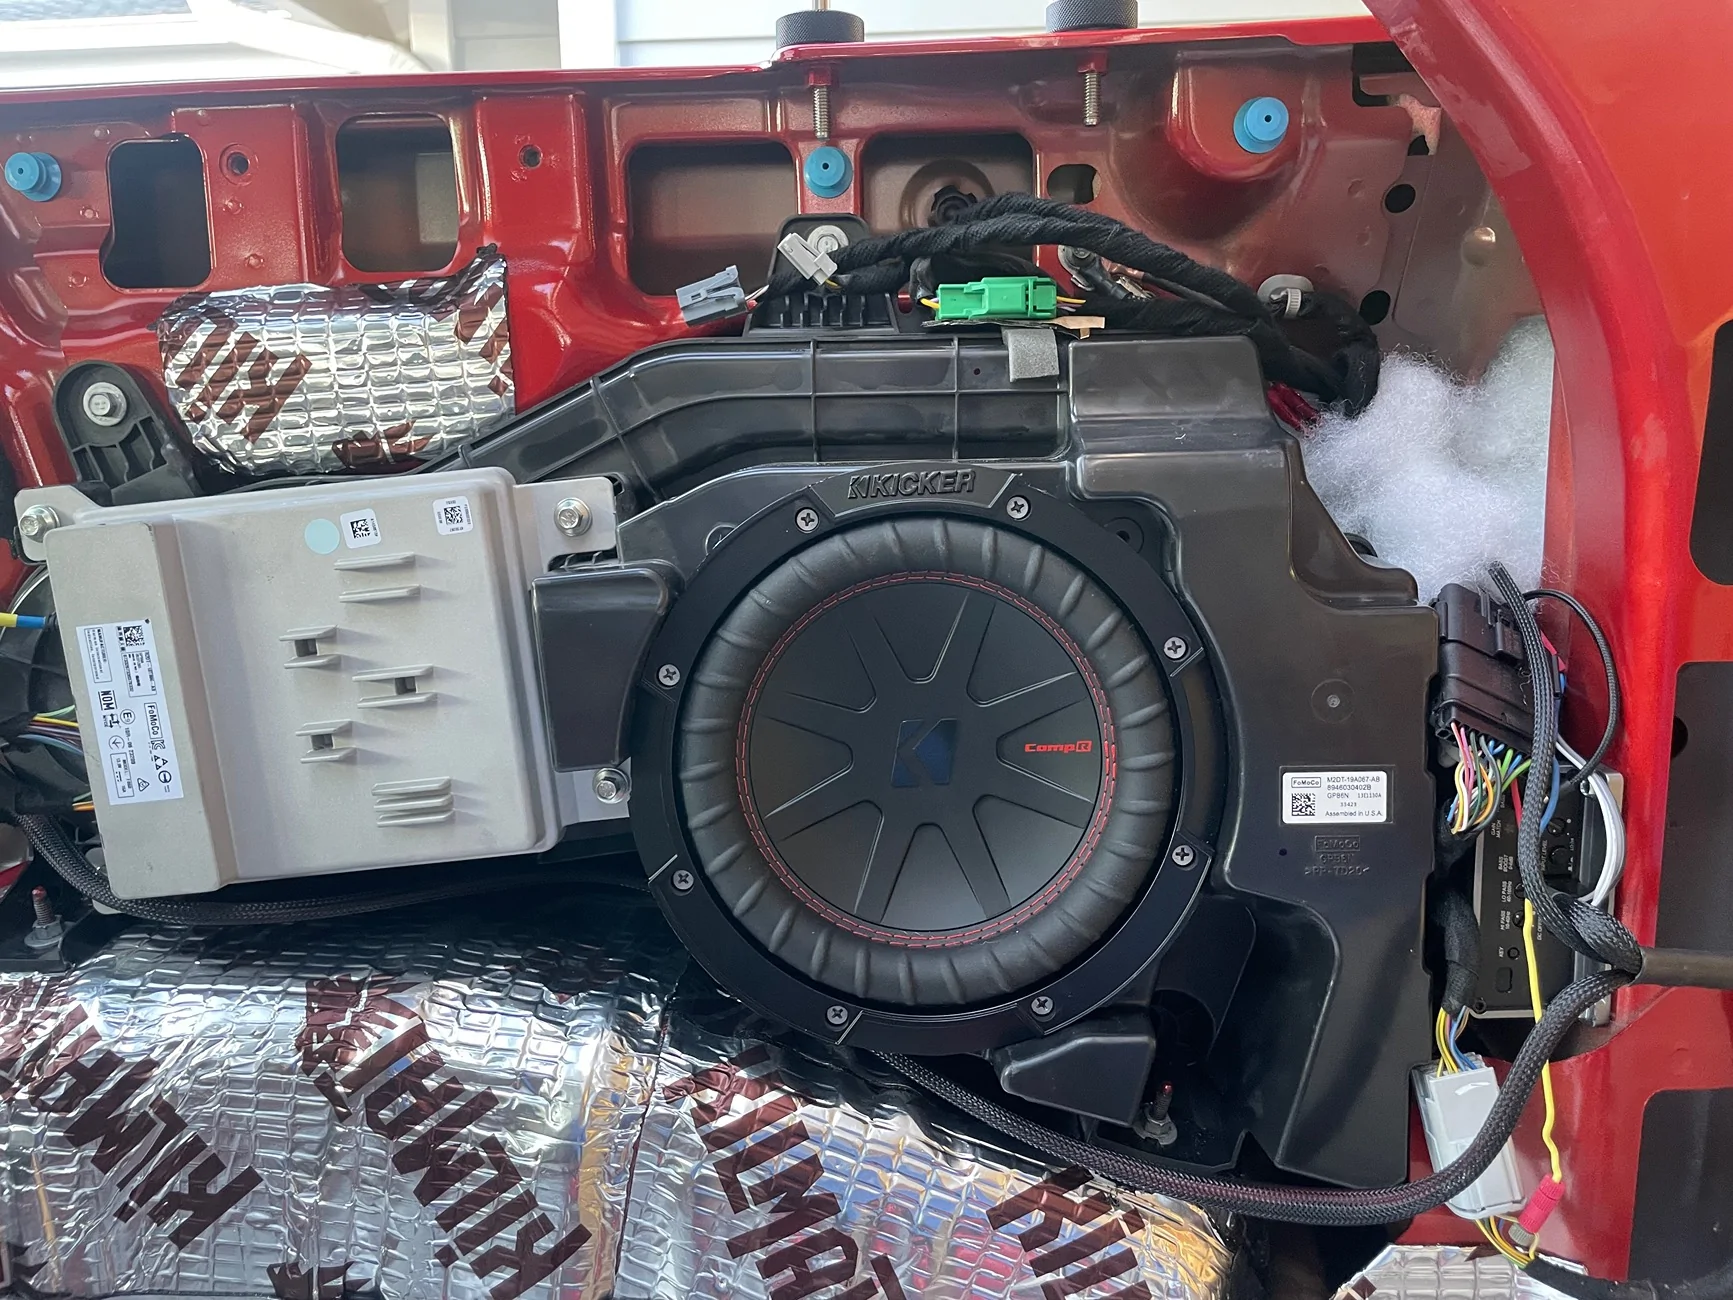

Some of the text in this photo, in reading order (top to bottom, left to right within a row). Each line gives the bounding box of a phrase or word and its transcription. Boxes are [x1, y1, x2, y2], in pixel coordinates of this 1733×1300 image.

[868, 469, 976, 497] KICKER
[101, 690, 115, 710] NOM
[146, 704, 159, 736] FoMoCo
